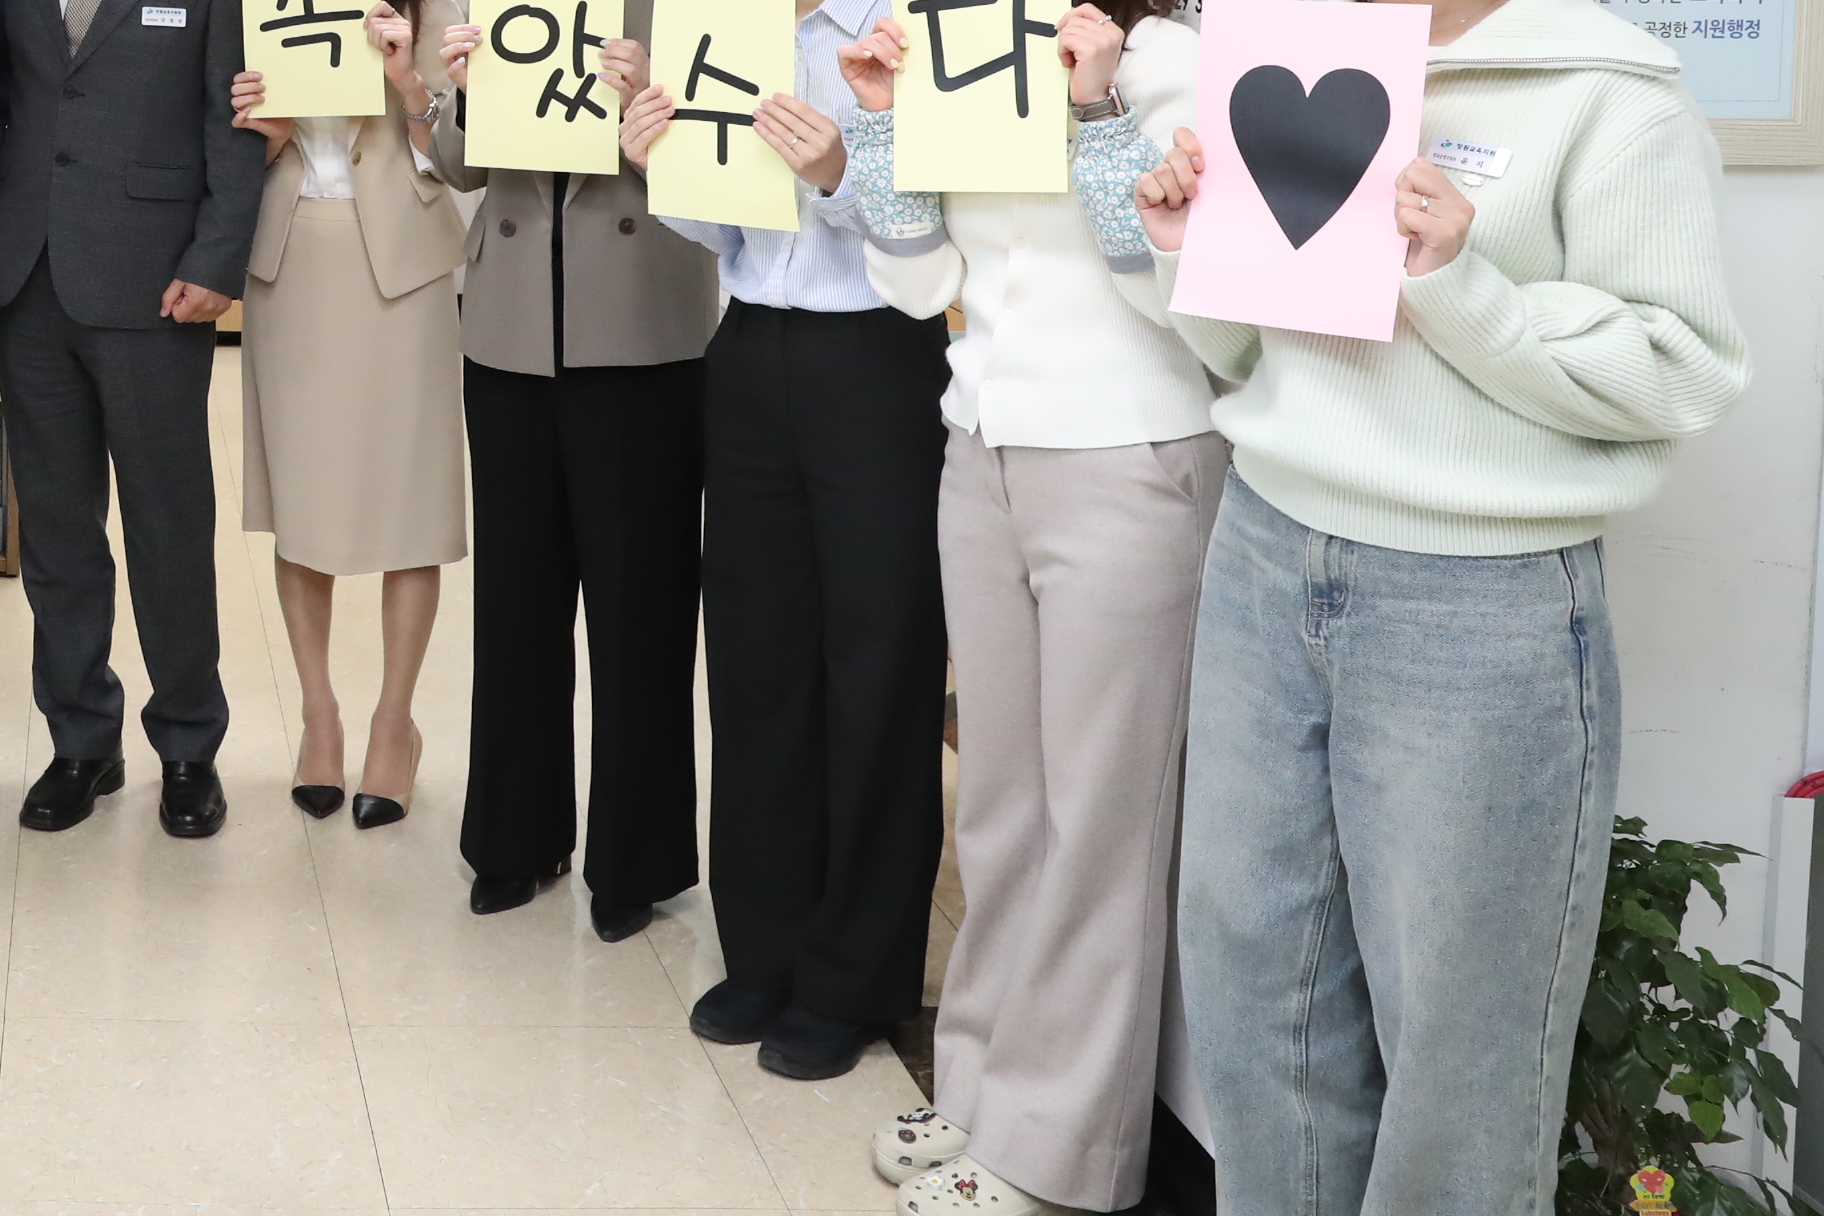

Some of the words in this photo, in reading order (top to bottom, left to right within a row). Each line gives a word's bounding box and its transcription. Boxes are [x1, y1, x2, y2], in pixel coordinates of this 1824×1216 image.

[491, 0, 611, 123] 았
[1643, 21, 1688, 39] 공정한
[1691, 19, 1761, 39] 지원행정
[670, 33, 762, 166] 수
